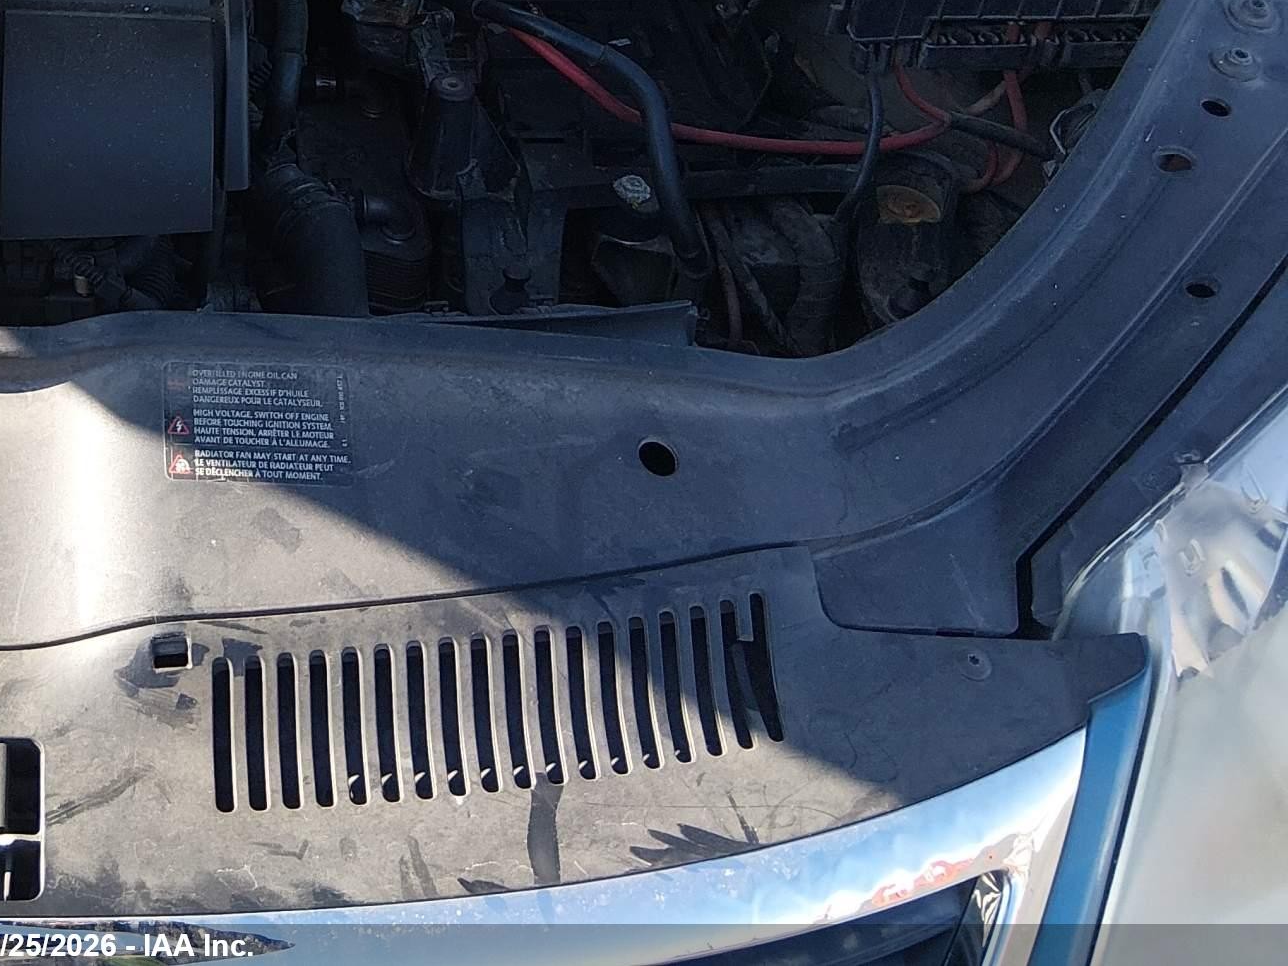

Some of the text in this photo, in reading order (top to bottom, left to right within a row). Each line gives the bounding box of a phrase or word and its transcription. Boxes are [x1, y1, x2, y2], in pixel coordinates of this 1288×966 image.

[266, 371, 280, 379] OIL
[281, 372, 298, 380] CAN
[192, 386, 242, 395] REMPLISSAGE
[245, 388, 277, 396] EXCESSIF
[193, 395, 240, 403] DANGEREUX
[263, 397, 272, 405] LE
[193, 408, 214, 416] HIGH
[254, 410, 283, 420] SWITCH
[285, 412, 300, 420] OFF
[301, 412, 329, 421] ENGINE
[193, 417, 221, 426] BEFORE
[223, 418, 263, 427] TOUCHING
[265, 420, 301, 429] IGNITION
[194, 427, 220, 435] HAUTE
[302, 431, 334, 440] MOTEUR
[194, 435, 221, 444] AVANT
[235, 437, 270, 445] TOUCHER
[194, 450, 352, 464] RADIATOR FAN MAY START AT ANY TIME.
[194, 458, 334, 472] LE VENTILATEUR DE RADIATEUR PEUT
[195, 467, 204, 475] SE
[255, 468, 261, 478] À
[262, 470, 284, 479] TOUT
[285, 471, 323, 481] MOMENT.
